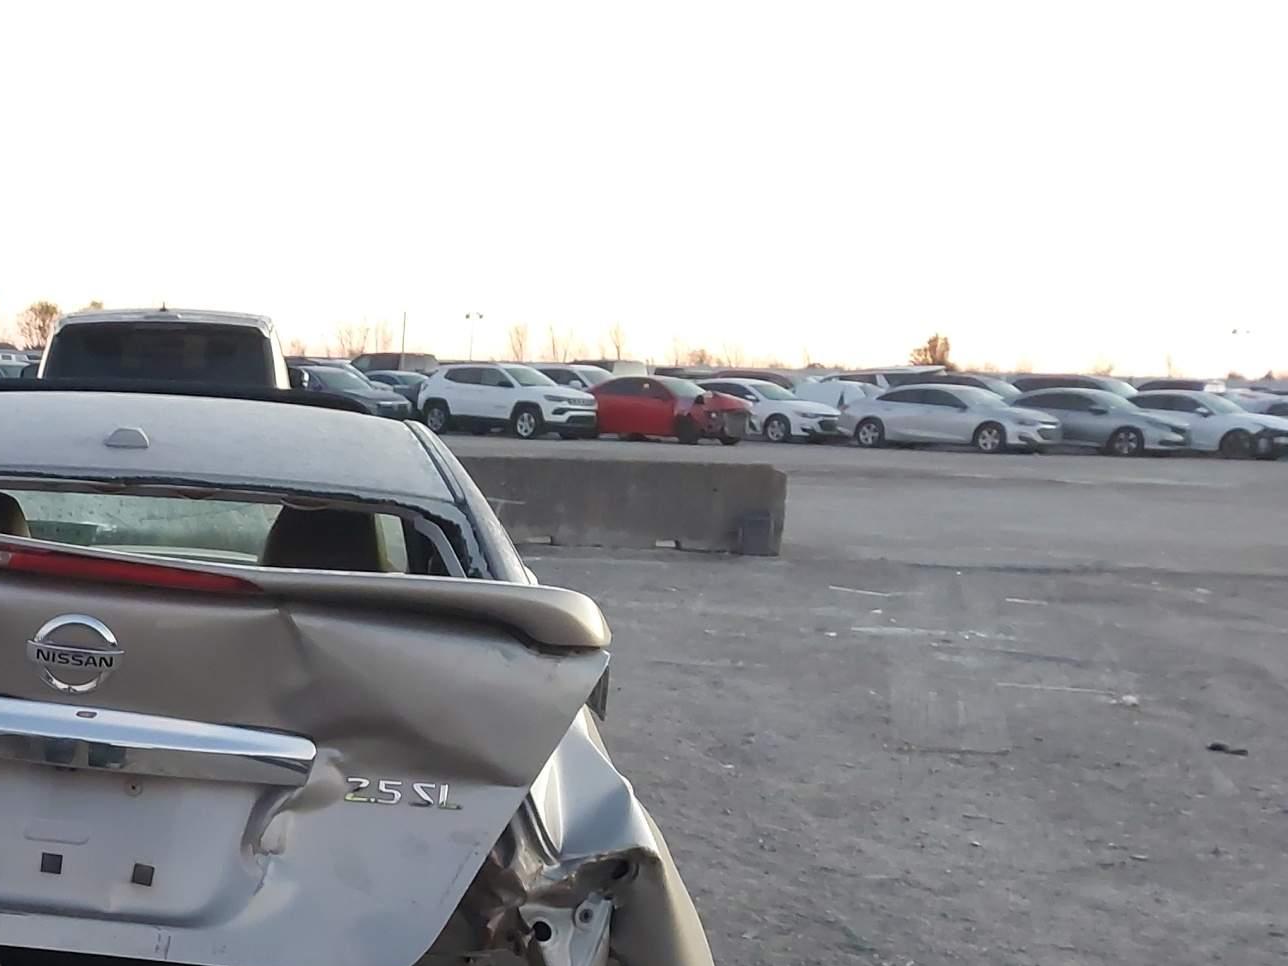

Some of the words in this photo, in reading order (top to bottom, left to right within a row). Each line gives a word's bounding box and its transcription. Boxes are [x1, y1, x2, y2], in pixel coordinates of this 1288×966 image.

[35, 648, 114, 668] NISSAN
[344, 776, 402, 805] 2.5
[408, 782, 462, 810] SL
